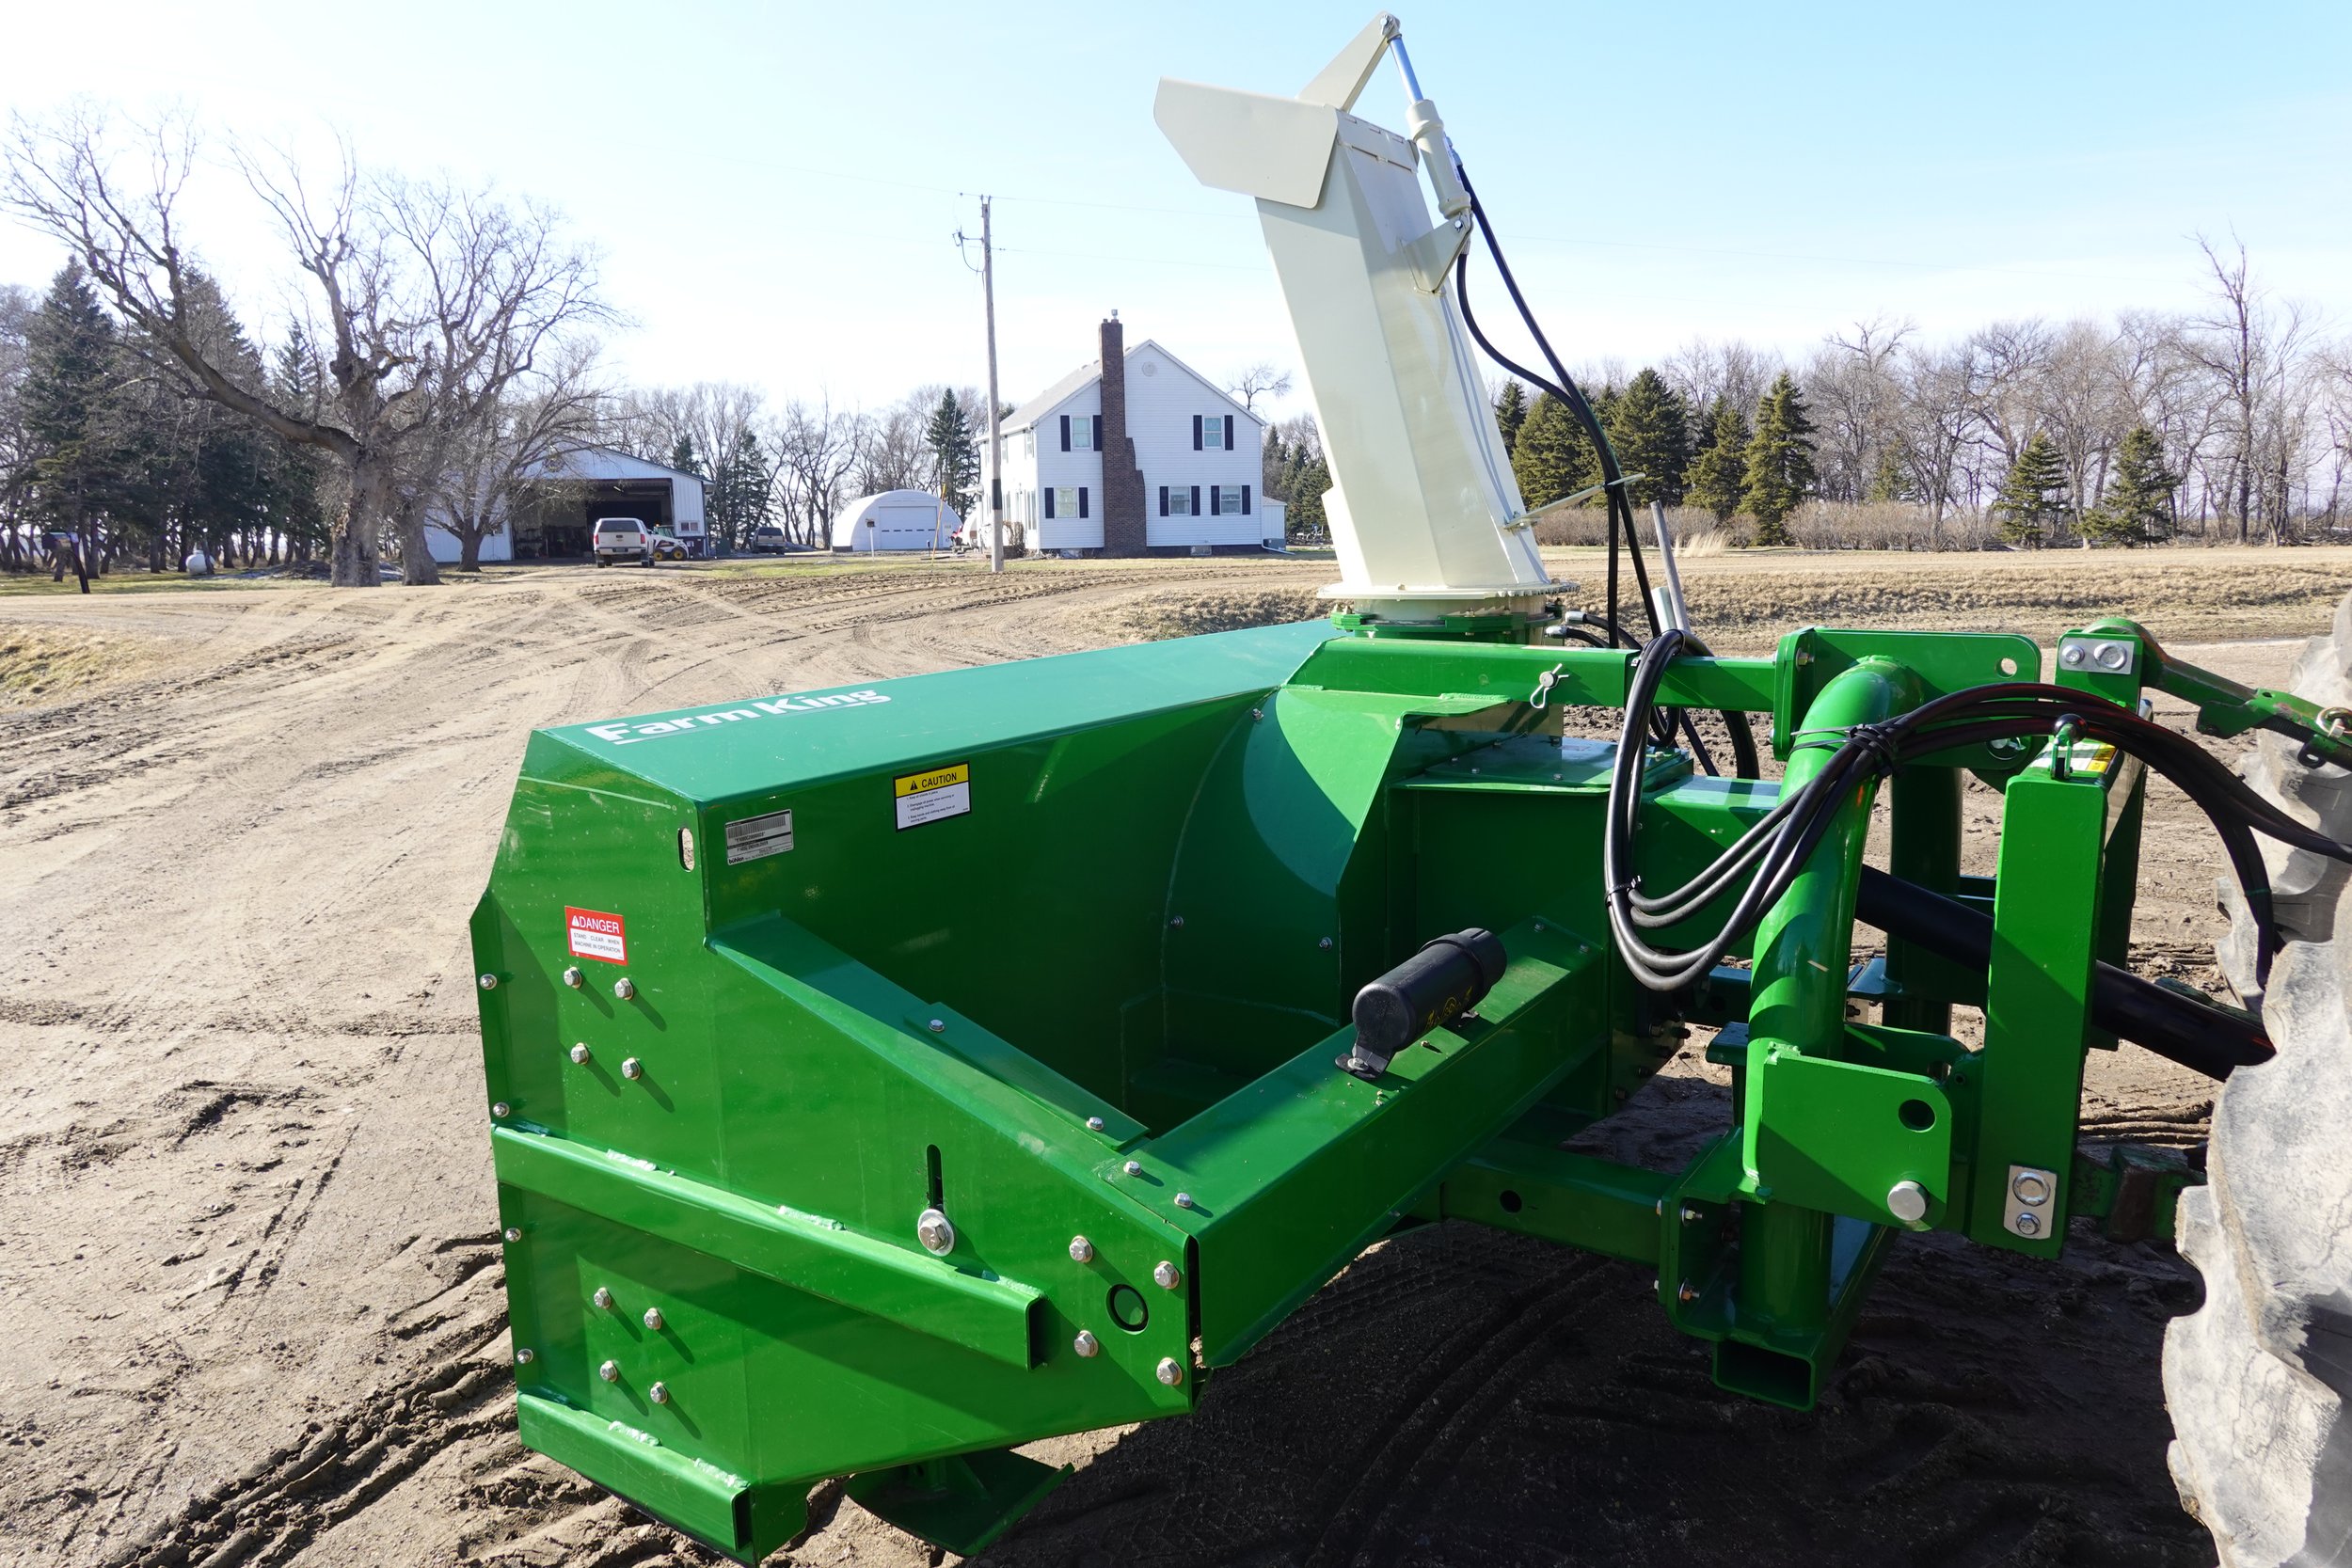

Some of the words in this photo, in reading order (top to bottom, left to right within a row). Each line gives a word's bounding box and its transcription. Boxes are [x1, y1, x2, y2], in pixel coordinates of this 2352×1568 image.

[584, 708, 762, 742] Farm
[753, 689, 892, 715] King
[922, 772, 957, 788] CAUTION
[580, 916, 619, 933] DANGER
